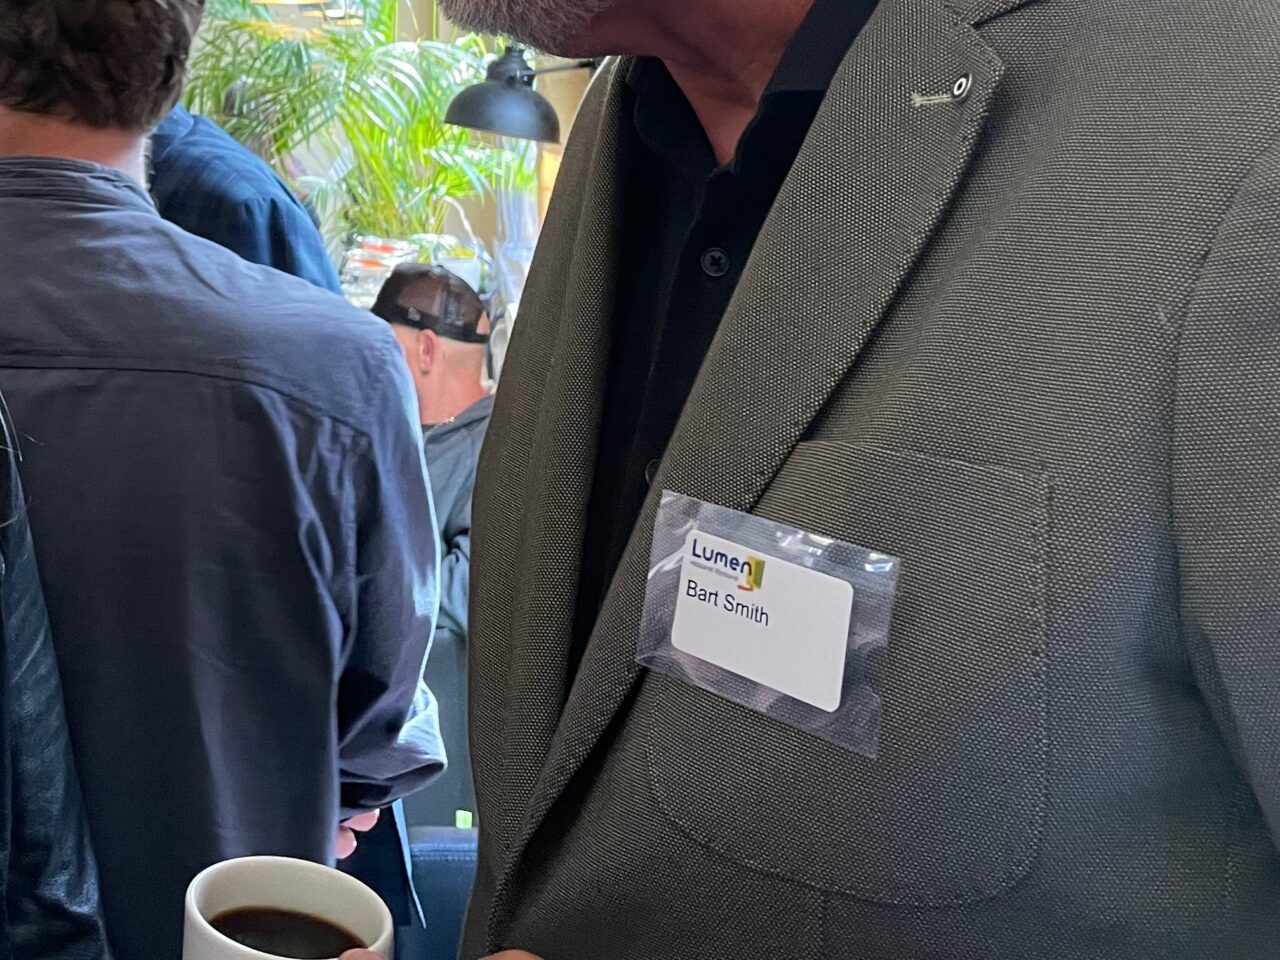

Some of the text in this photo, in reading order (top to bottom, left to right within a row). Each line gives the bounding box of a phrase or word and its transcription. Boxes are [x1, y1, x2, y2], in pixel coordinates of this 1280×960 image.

[692, 538, 753, 576] Lumen
[686, 579, 769, 627] Bart Smith
